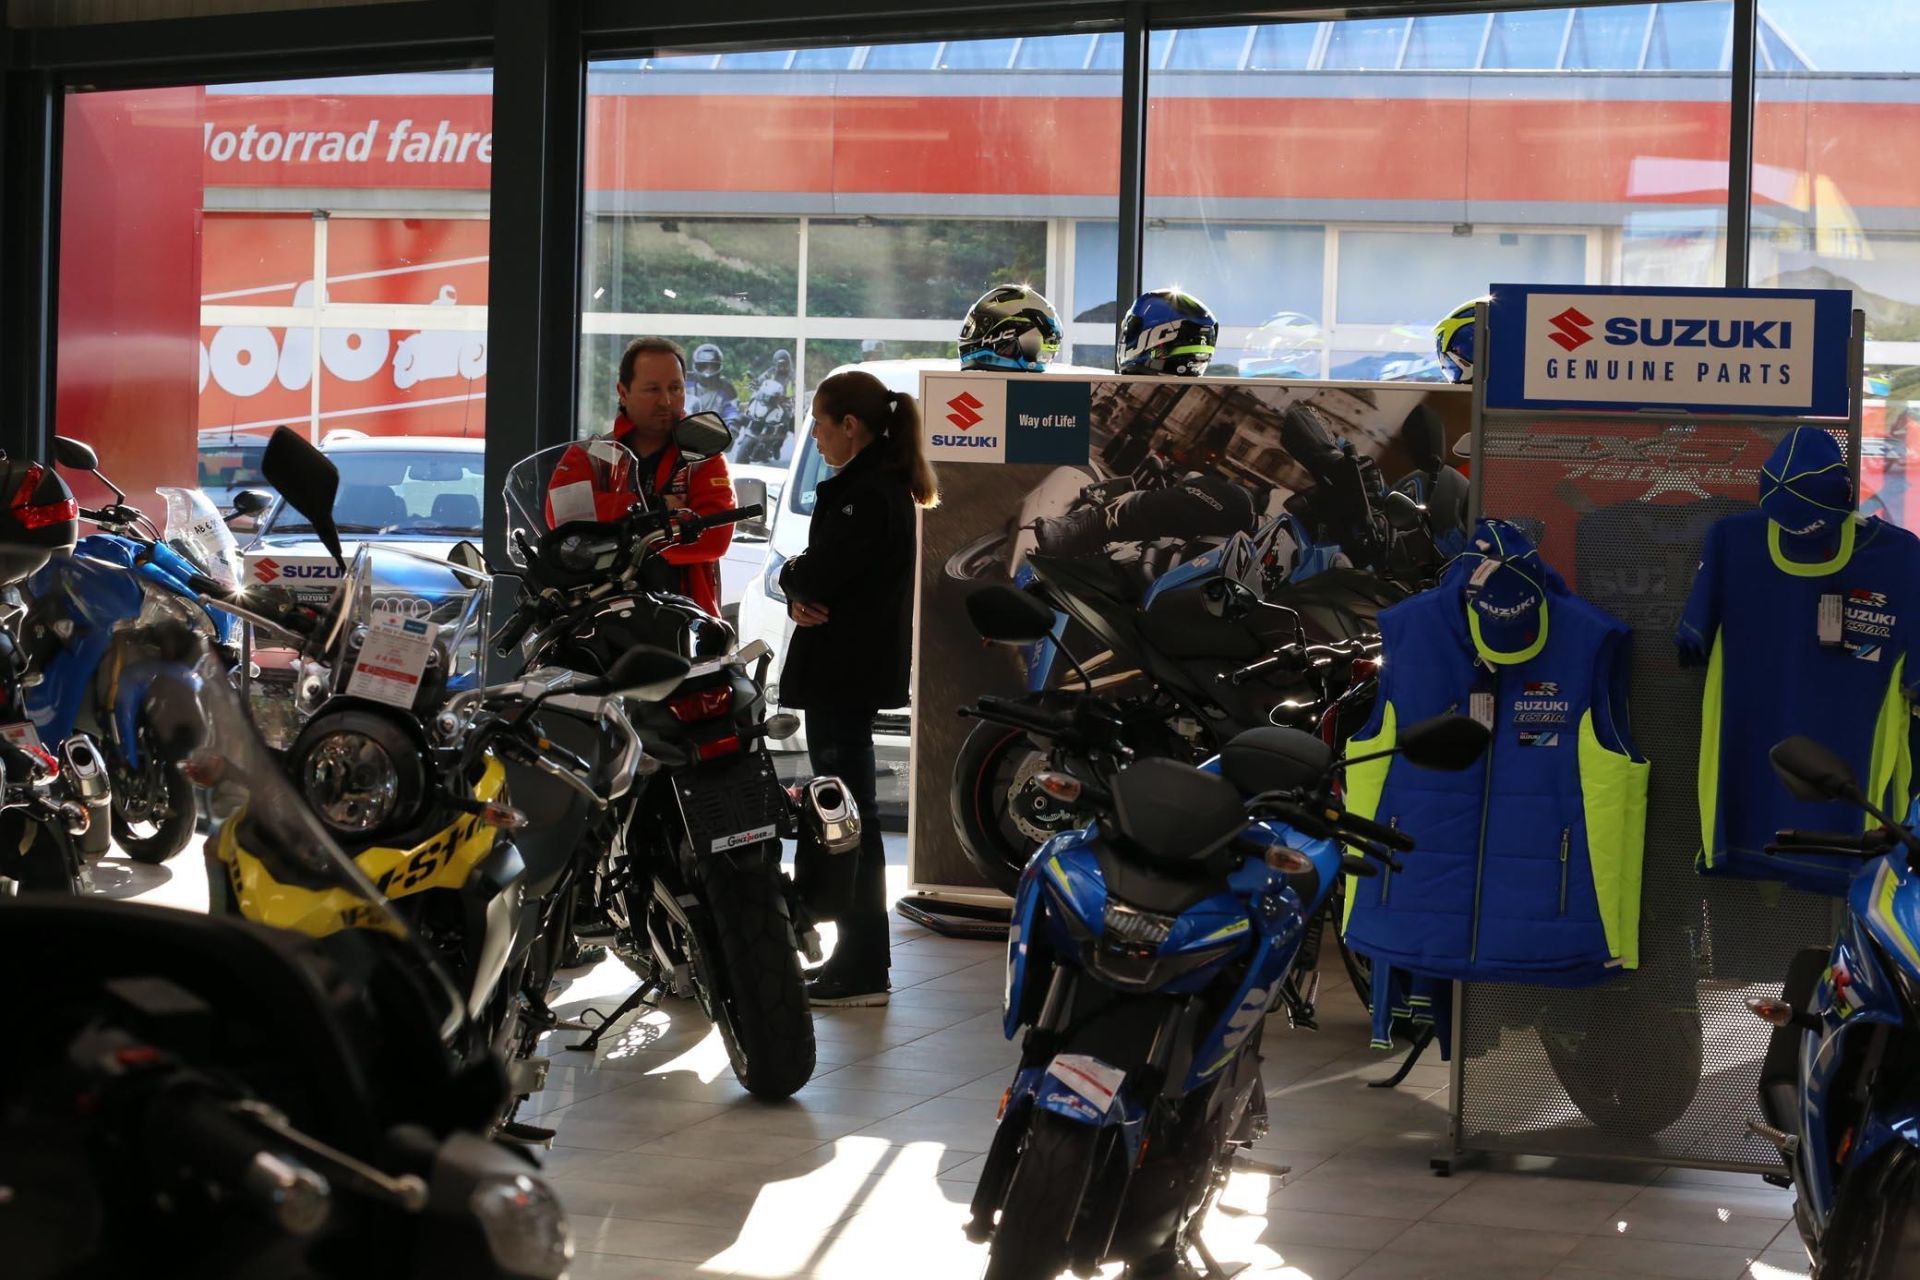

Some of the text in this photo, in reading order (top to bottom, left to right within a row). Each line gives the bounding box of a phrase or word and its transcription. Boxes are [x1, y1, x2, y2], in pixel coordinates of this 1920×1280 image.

[1604, 317, 1792, 349] SUZUKI
[1546, 358, 1791, 384] GENUINE PARTS
[1019, 414, 1076, 429] Way of Life!
[931, 434, 997, 448] SUZUKI
[283, 565, 342, 579] SUZU
[1513, 700, 1569, 712] SUZUKI
